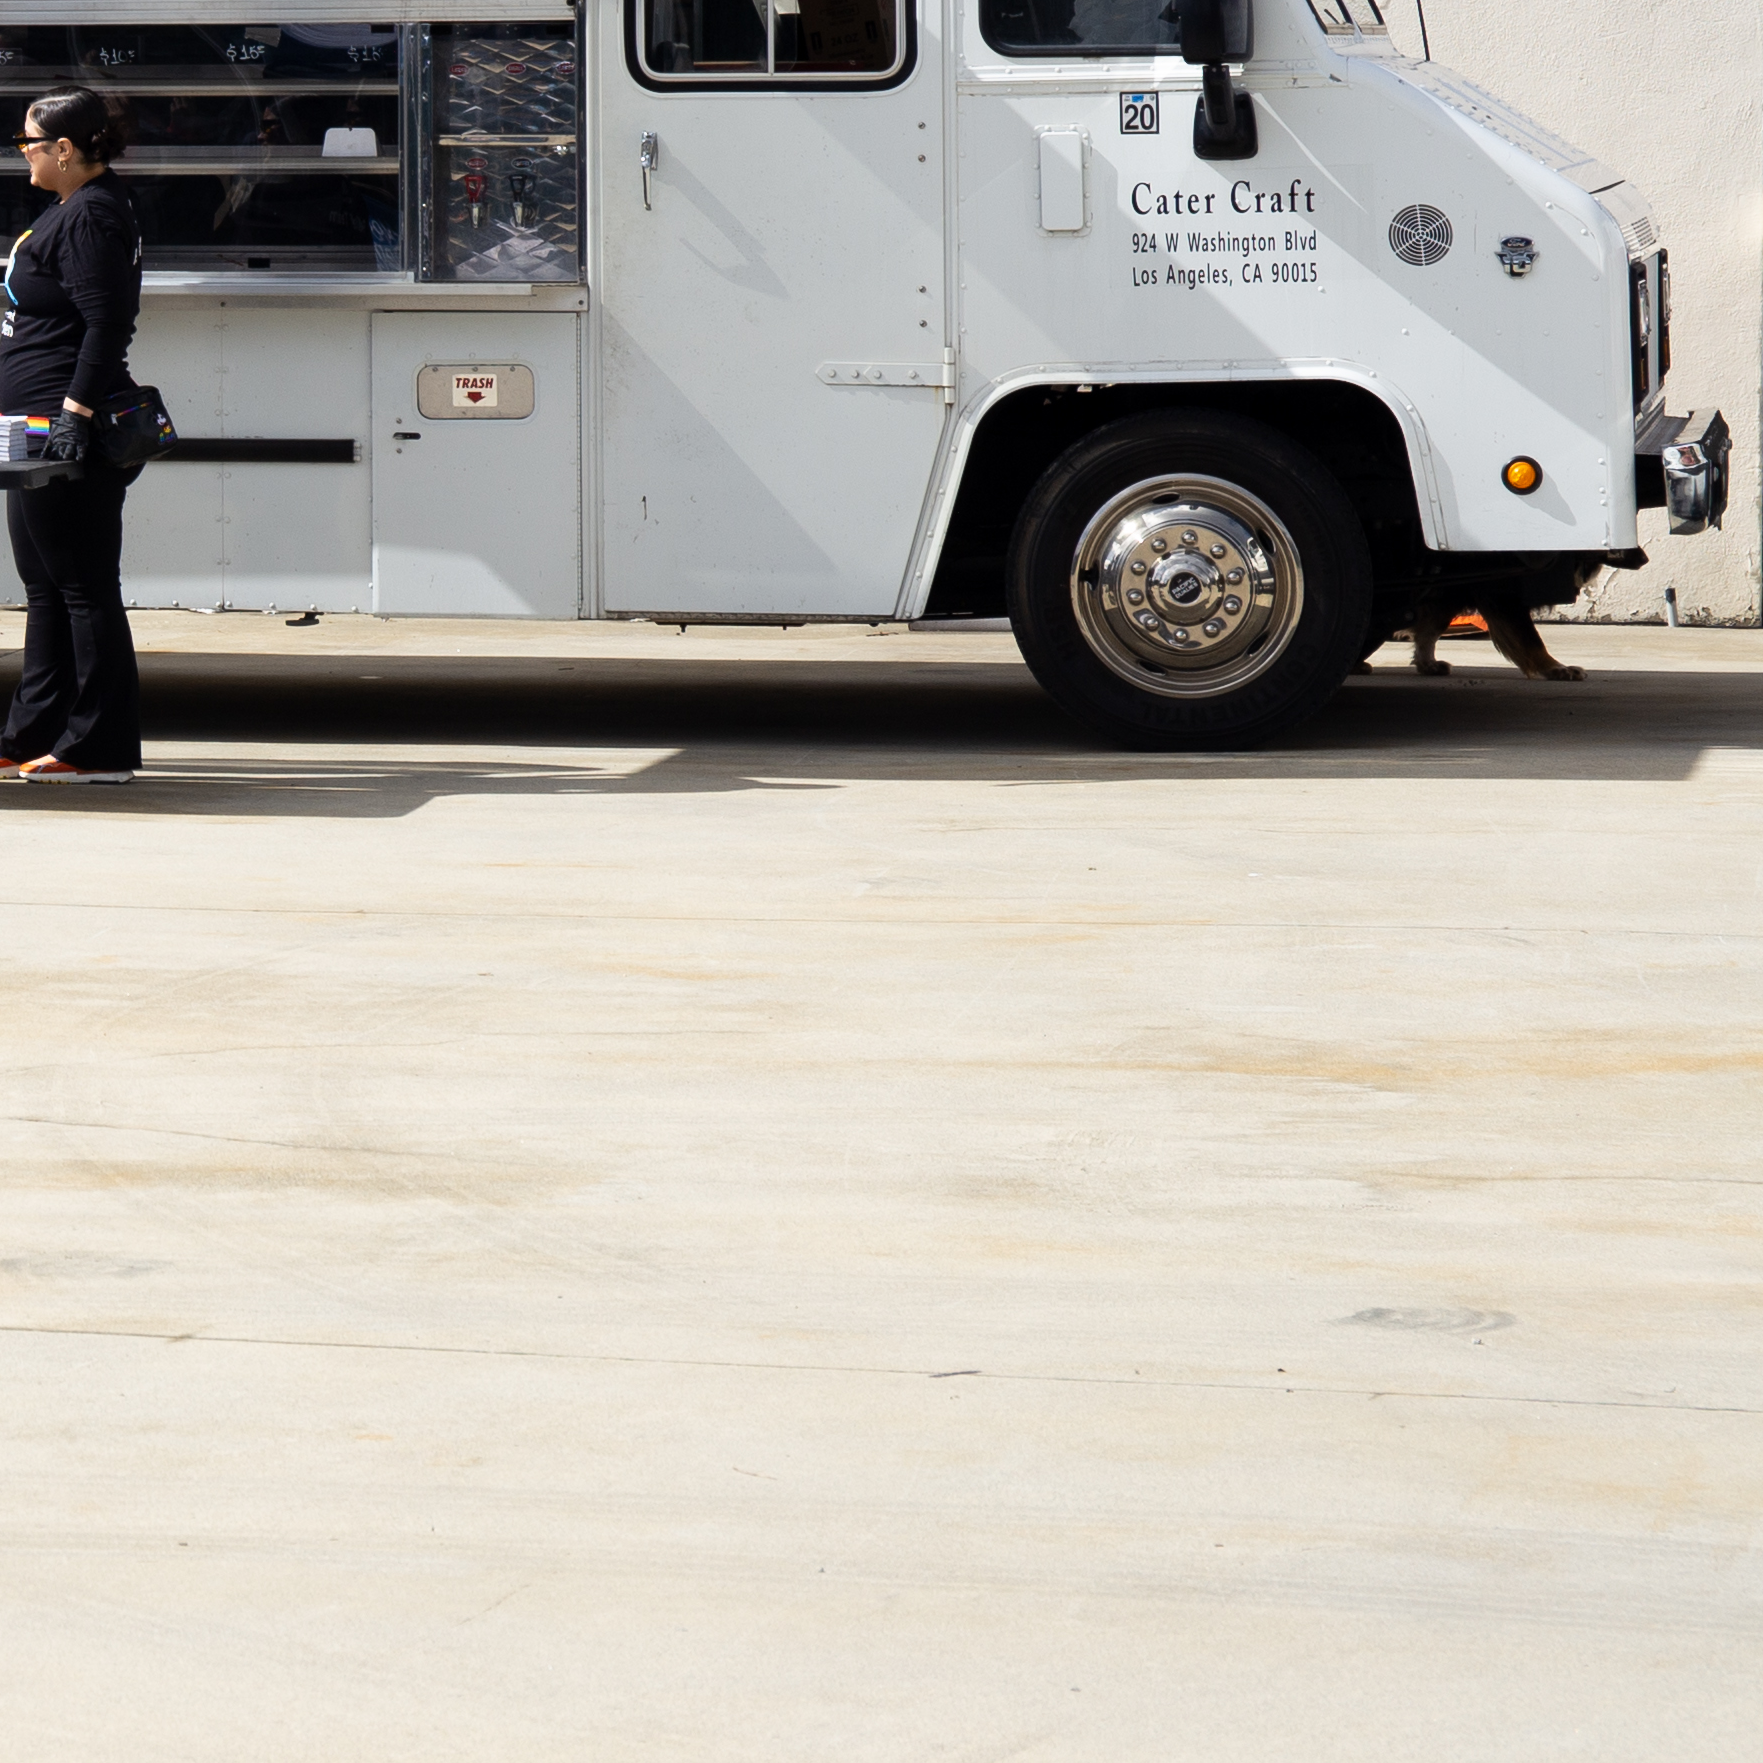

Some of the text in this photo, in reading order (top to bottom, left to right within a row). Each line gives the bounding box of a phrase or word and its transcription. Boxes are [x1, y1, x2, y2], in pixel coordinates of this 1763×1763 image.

[1124, 103, 1155, 130] 20
[1131, 179, 1316, 215] Cater Craft
[1132, 229, 1317, 258] 924 W Washington Blvd
[1132, 262, 1318, 290] Los Angeles, CA 90015
[455, 377, 494, 389] TRASH
